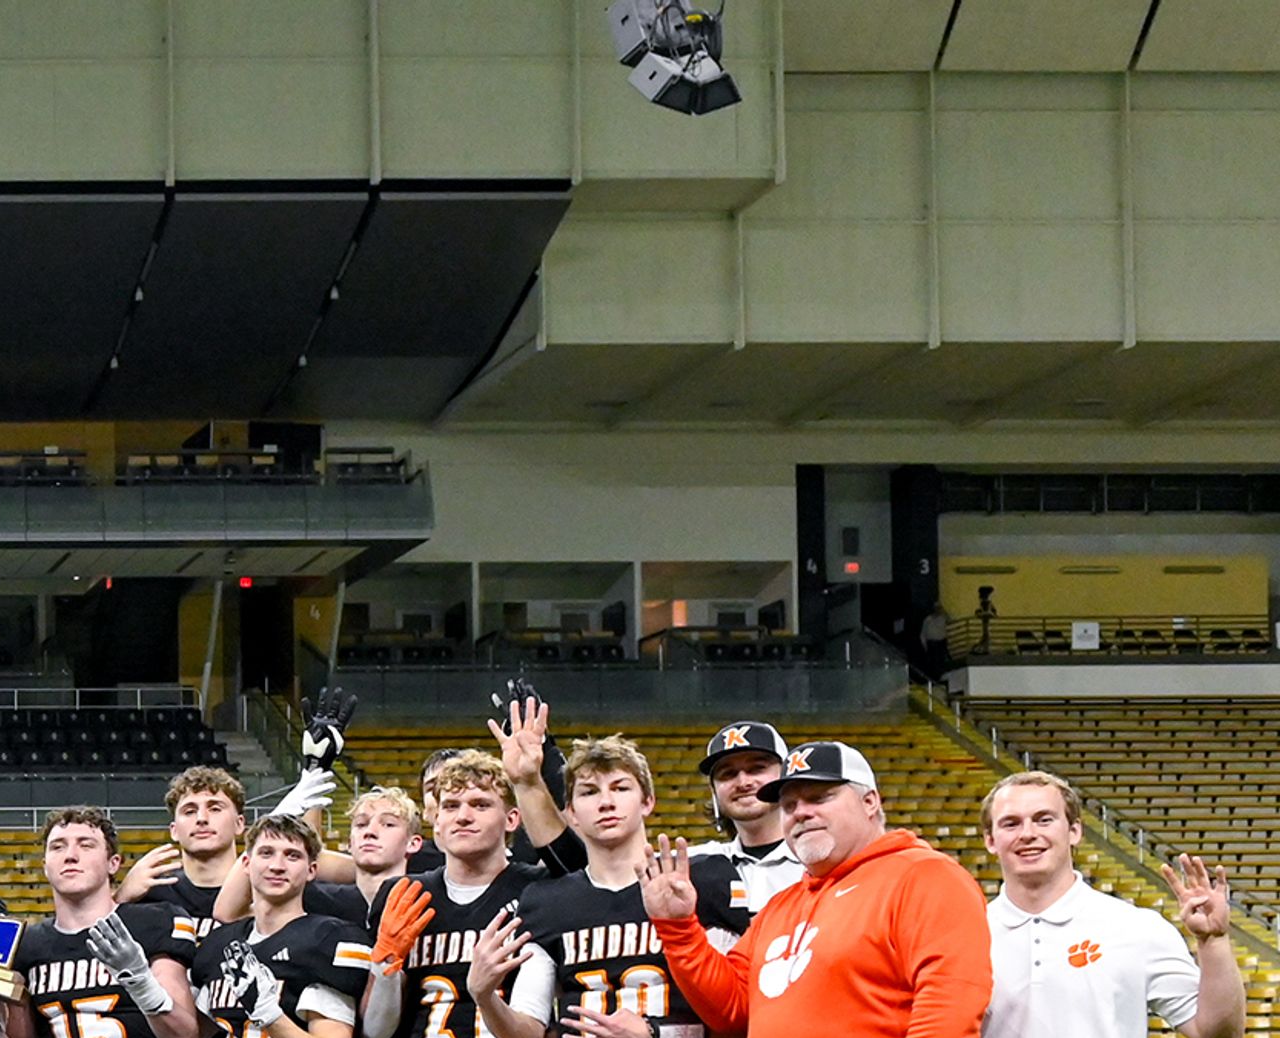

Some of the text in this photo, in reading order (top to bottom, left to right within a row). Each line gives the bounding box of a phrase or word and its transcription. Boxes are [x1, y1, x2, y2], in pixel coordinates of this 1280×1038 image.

[806, 558, 817, 574] 4
[920, 559, 930, 574] 3
[722, 725, 751, 750] K
[786, 747, 815, 776] K
[562, 921, 663, 965] KENDRIC
